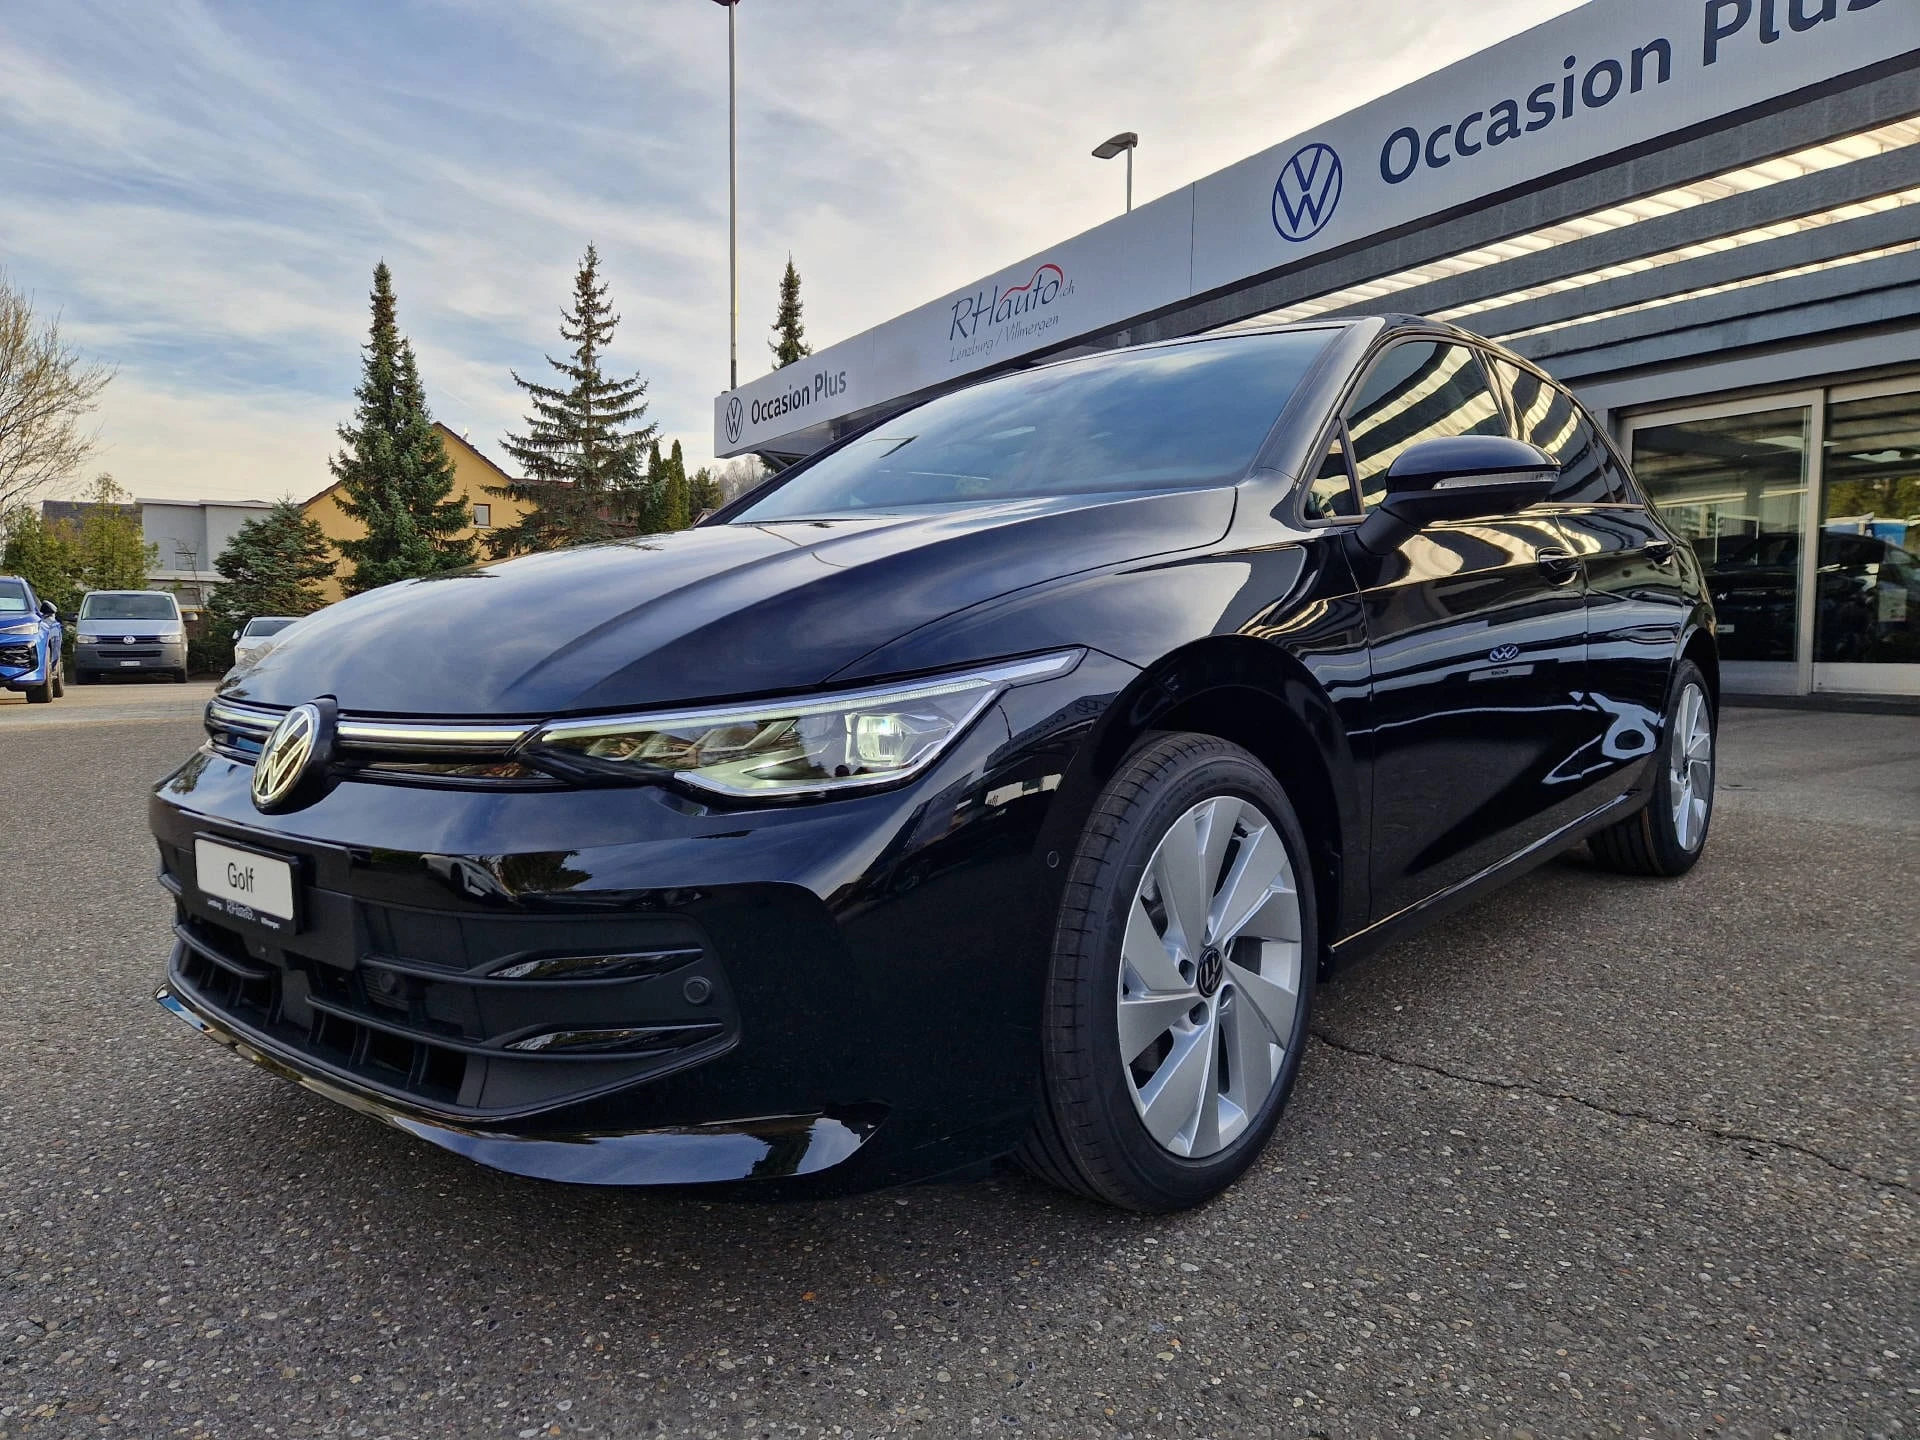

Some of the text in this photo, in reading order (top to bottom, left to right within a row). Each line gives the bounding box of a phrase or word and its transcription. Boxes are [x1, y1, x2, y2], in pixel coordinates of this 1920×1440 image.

[1380, 0, 1881, 184] Occasion Plu
[751, 369, 847, 425] Occasion Plus
[226, 861, 255, 893] Golf
